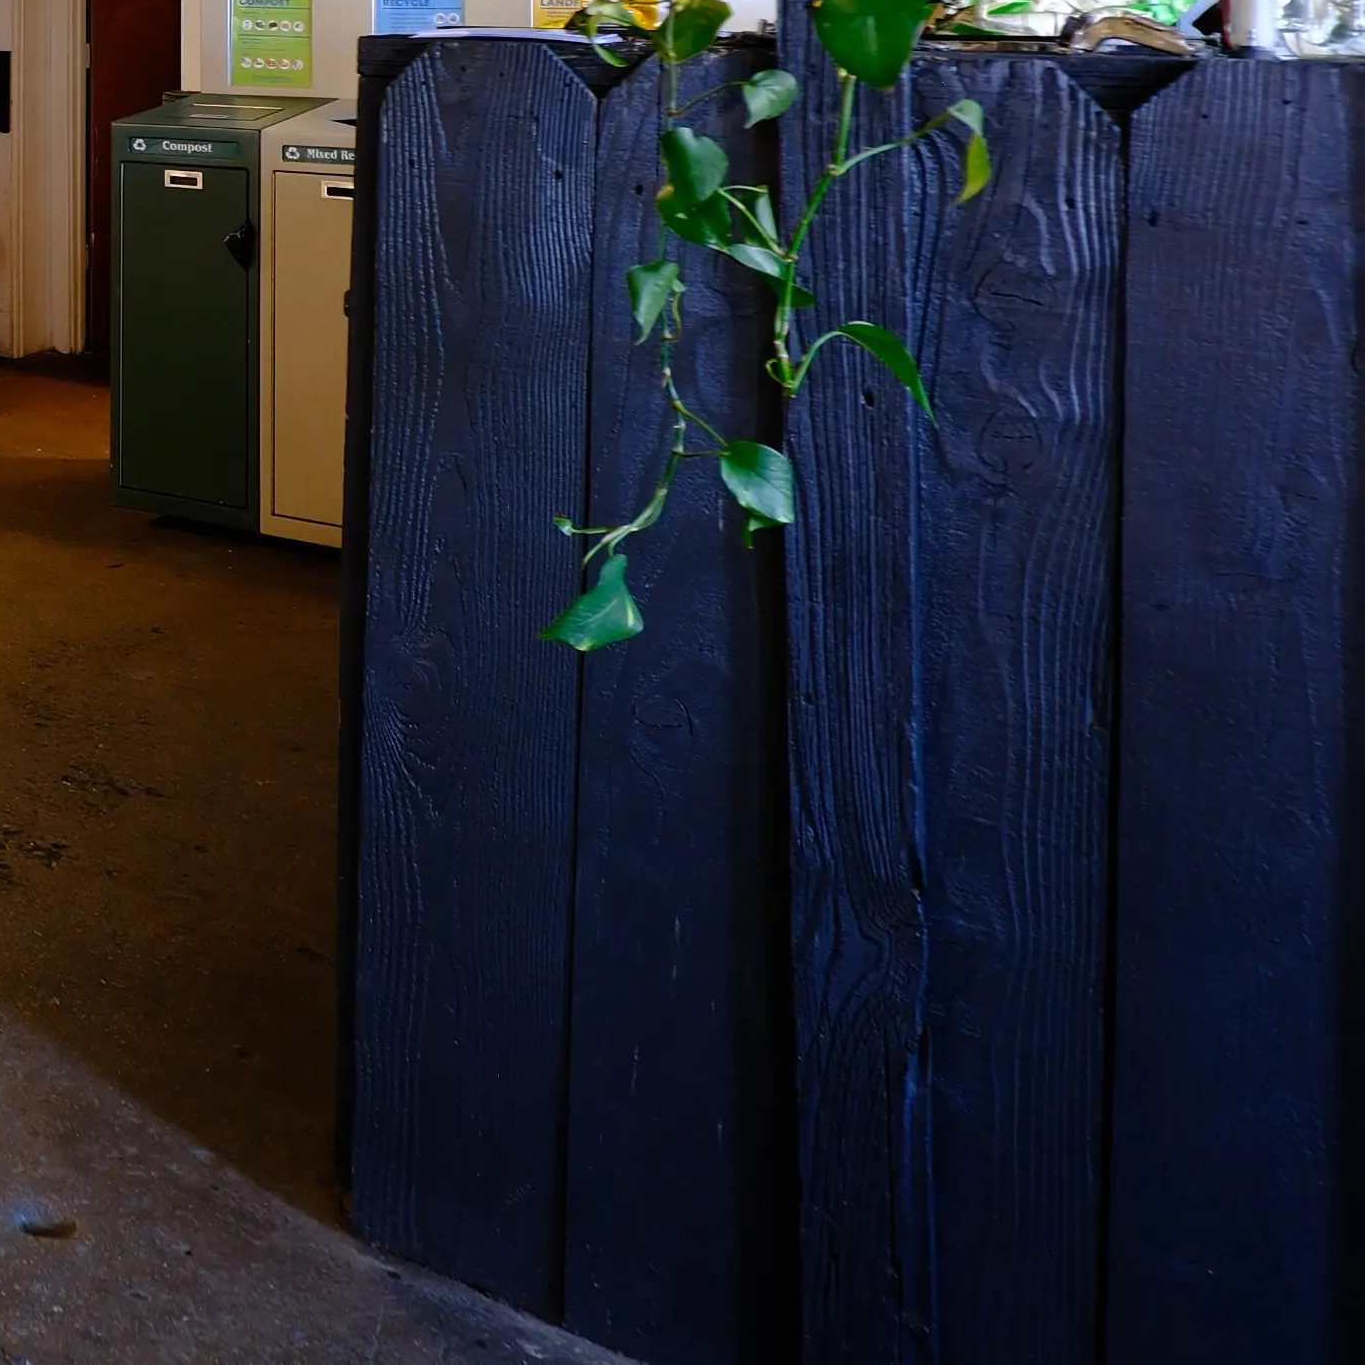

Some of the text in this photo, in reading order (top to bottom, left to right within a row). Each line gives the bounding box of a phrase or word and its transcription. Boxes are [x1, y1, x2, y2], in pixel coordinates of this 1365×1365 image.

[162, 140, 214, 153] Compost
[306, 149, 356, 161] Mixed Re
